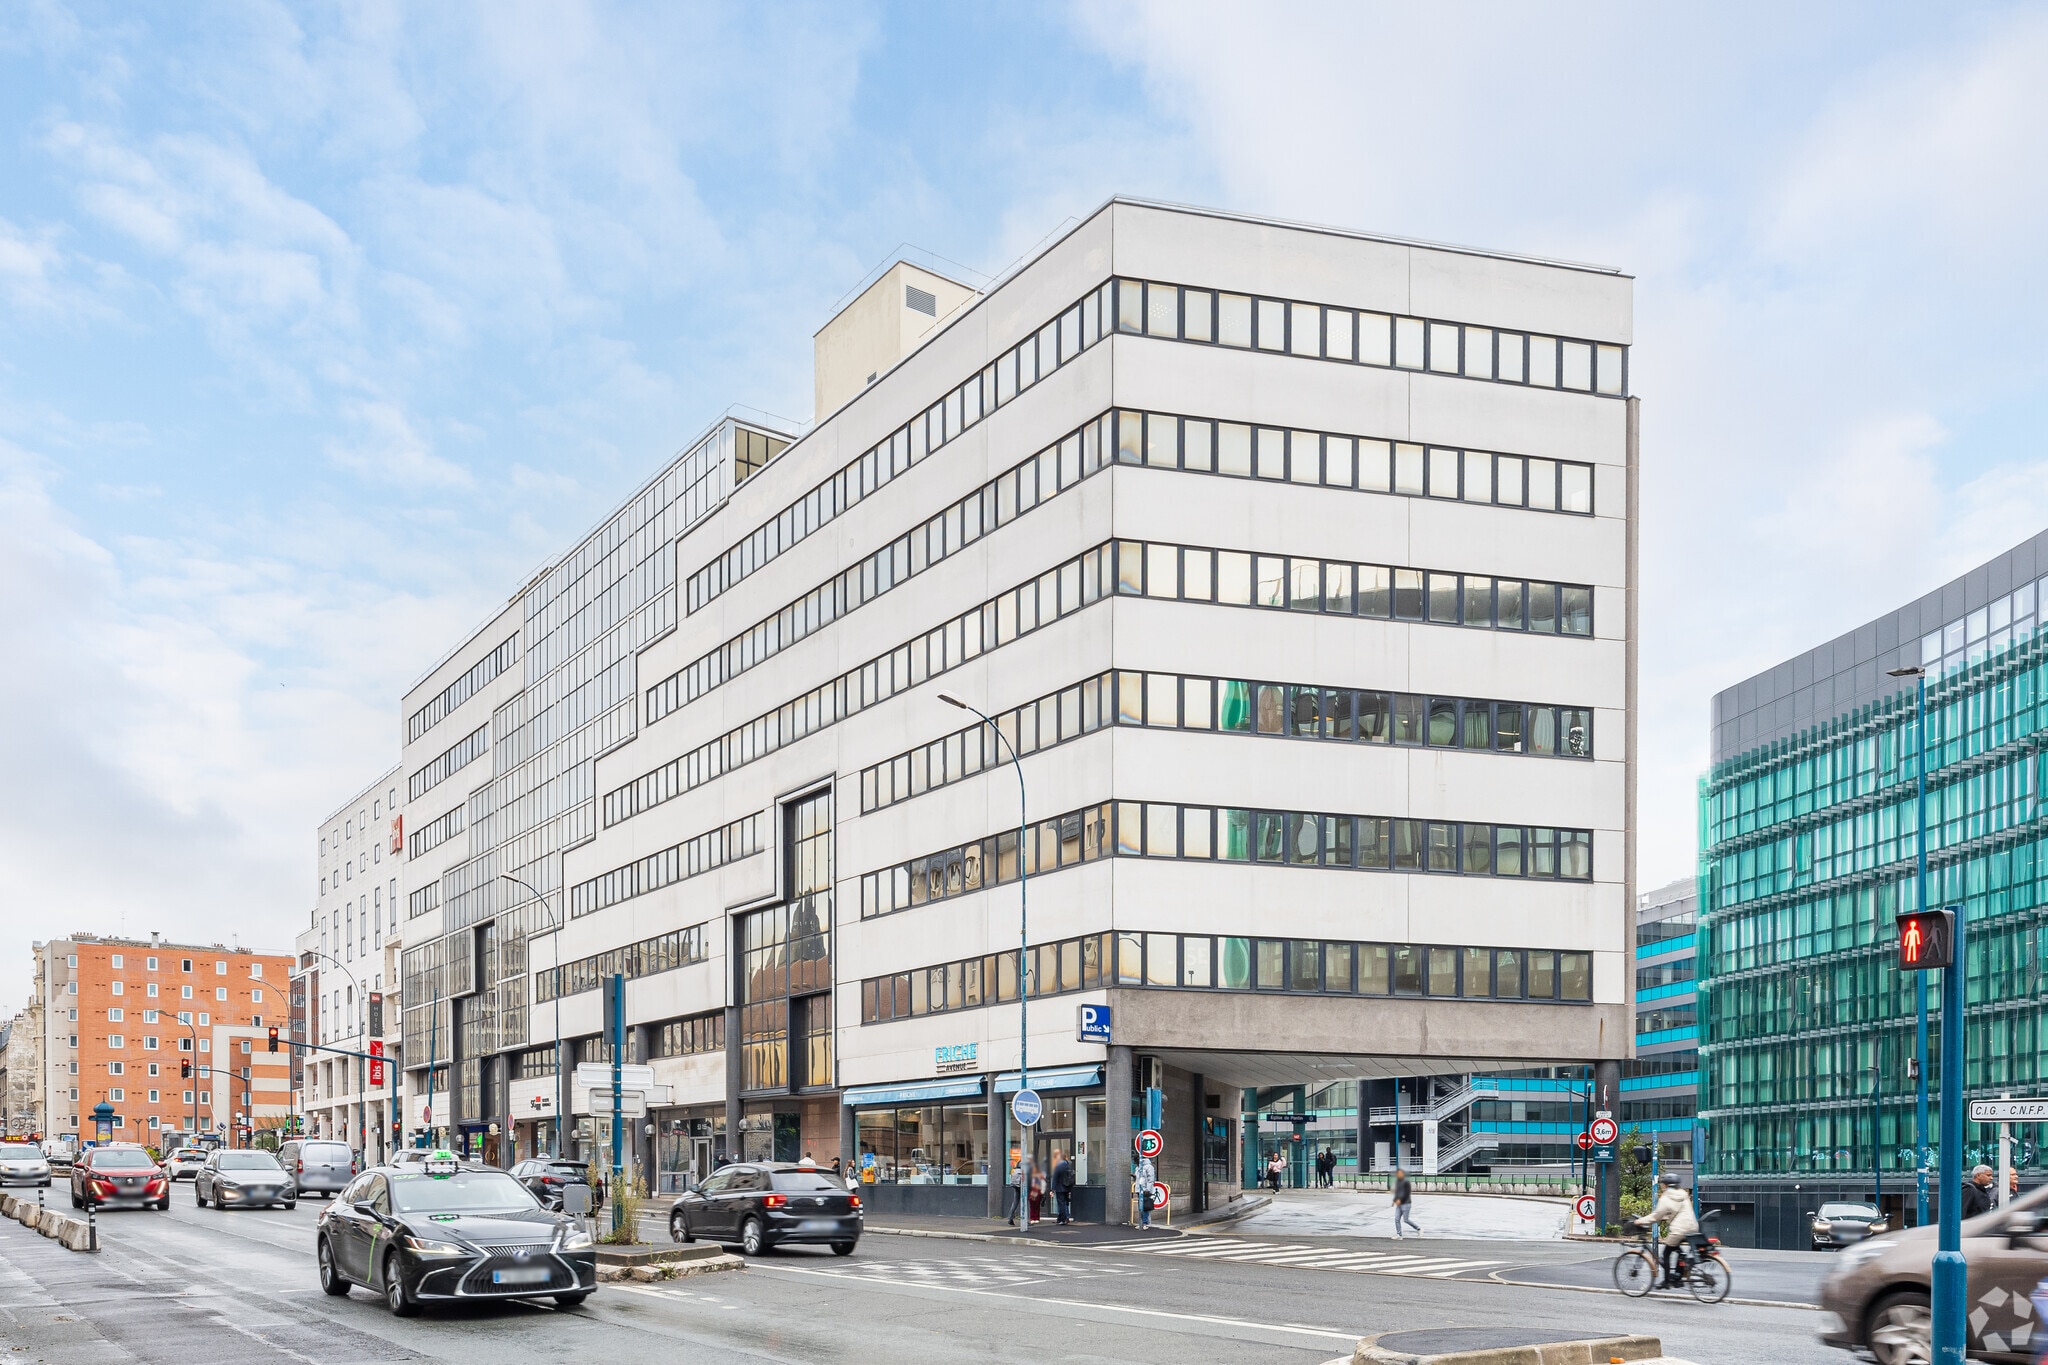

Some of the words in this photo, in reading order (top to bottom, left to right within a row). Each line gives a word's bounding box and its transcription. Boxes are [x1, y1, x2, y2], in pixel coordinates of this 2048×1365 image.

[935, 1042, 977, 1063] FRICHE
[945, 1062, 967, 1072] AVENUE
[1975, 1106, 1999, 1116] C.I.G.
[2009, 1105, 2048, 1116] C.N.F.P.
[1595, 1127, 1612, 1136] 3,6m
